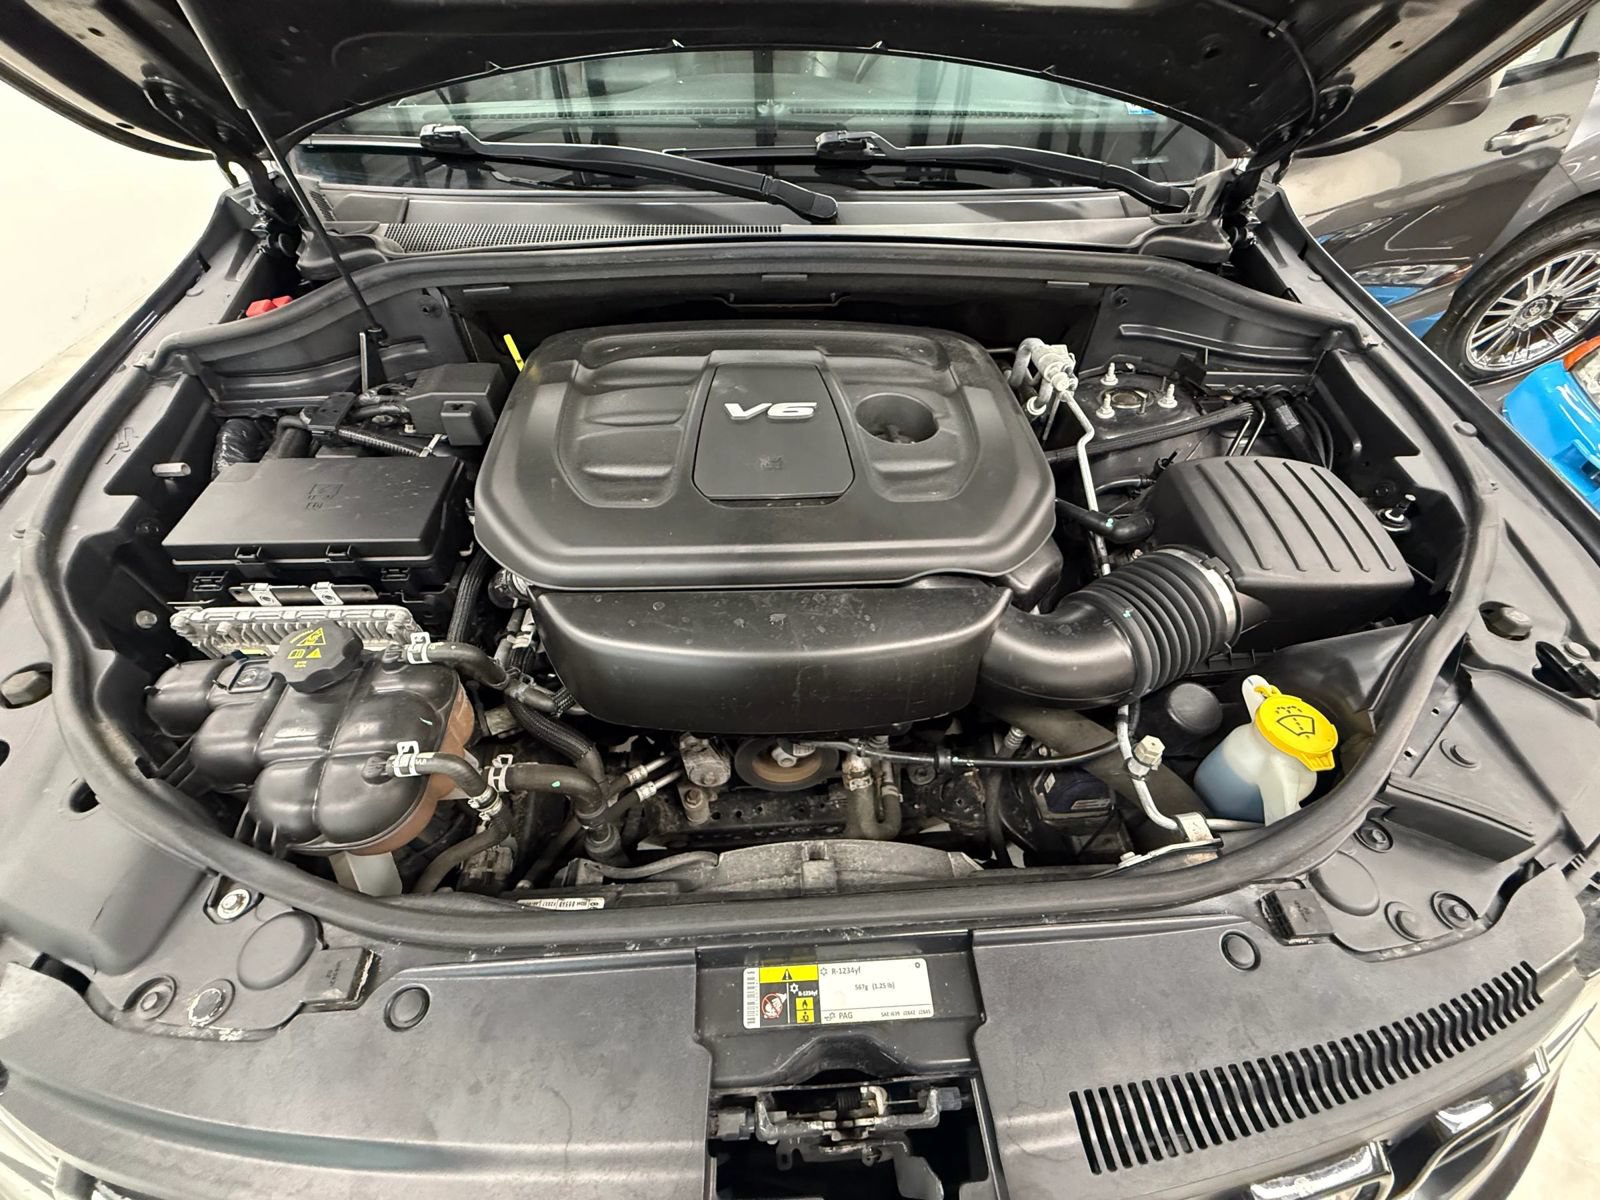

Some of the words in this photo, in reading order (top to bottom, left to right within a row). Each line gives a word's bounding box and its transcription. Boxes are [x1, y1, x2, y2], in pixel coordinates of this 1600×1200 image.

[724, 402, 817, 420] V6
[831, 966, 861, 975] R-1234yf
[854, 983, 868, 991] 567g
[838, 1011, 853, 1019] PAG
